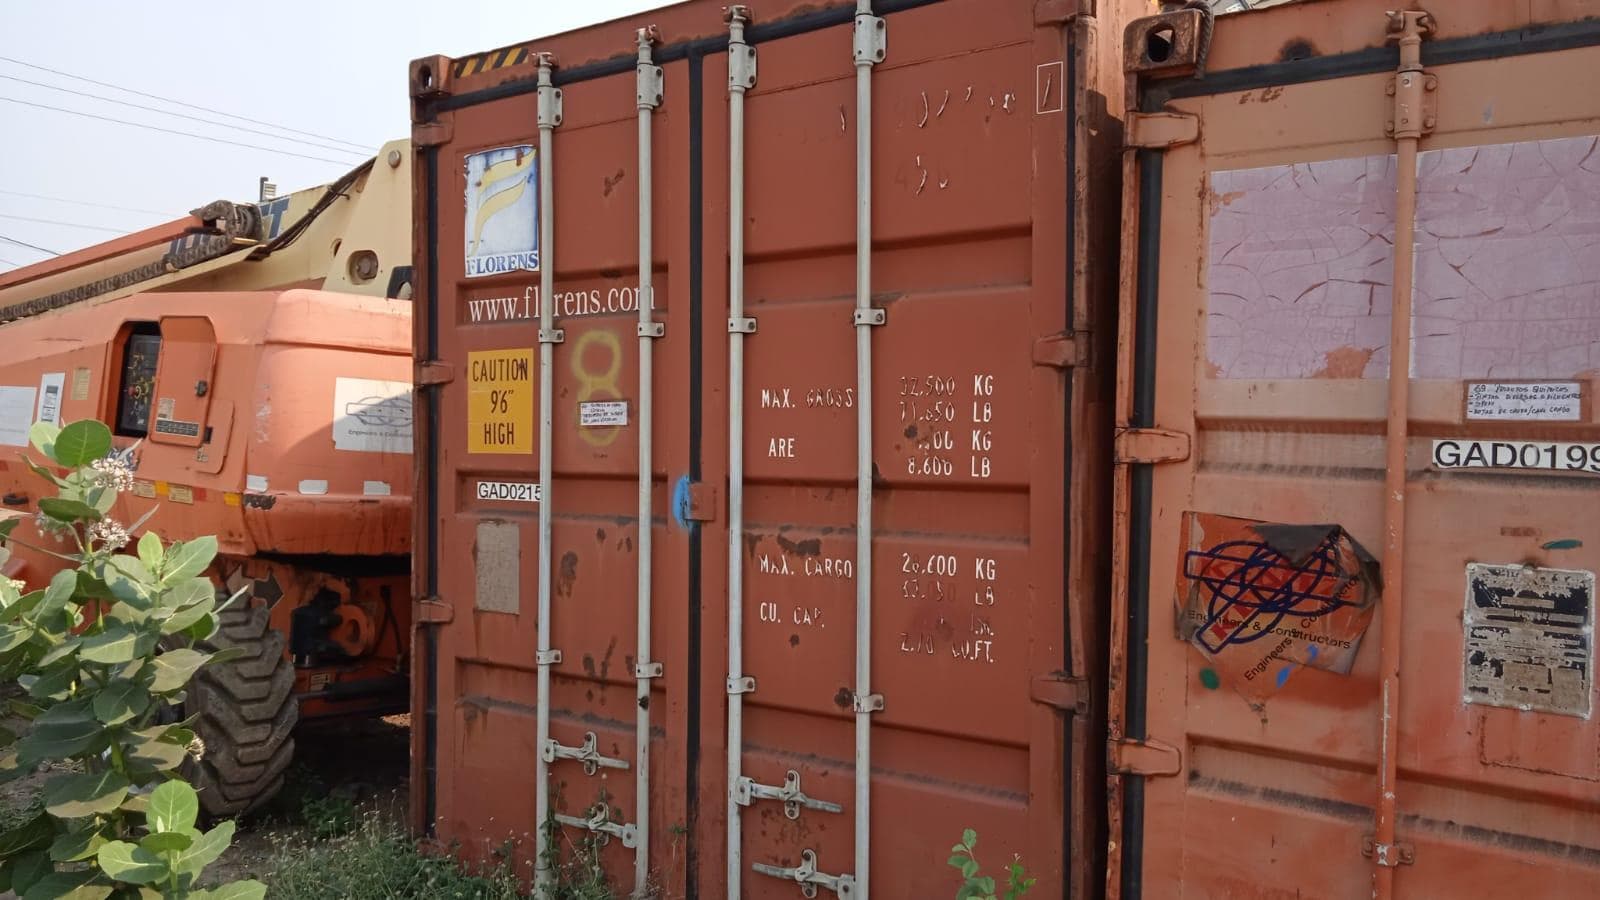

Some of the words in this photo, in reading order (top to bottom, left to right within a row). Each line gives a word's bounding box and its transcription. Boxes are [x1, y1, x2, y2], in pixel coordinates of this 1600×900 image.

[466, 252, 539, 275] FLORENS
[469, 285, 655, 322] www.flrens.co
[472, 358, 528, 382] CAUTION
[761, 388, 796, 408] MAX.
[806, 388, 853, 408] GROSS
[974, 374, 993, 396] KG
[973, 401, 992, 423] LB
[484, 423, 514, 445] HIGH
[768, 438, 795, 457] ARE
[972, 429, 991, 451] KG
[971, 456, 990, 477] LB
[478, 483, 541, 500] GAD0215
[760, 554, 795, 575] MAX.
[804, 557, 853, 578] CARGO
[975, 558, 995, 580] KG
[975, 586, 994, 606] LB
[760, 602, 782, 624] CU.
[1252, 621, 1262, 631] &
[1244, 637, 1293, 681] Engineers
